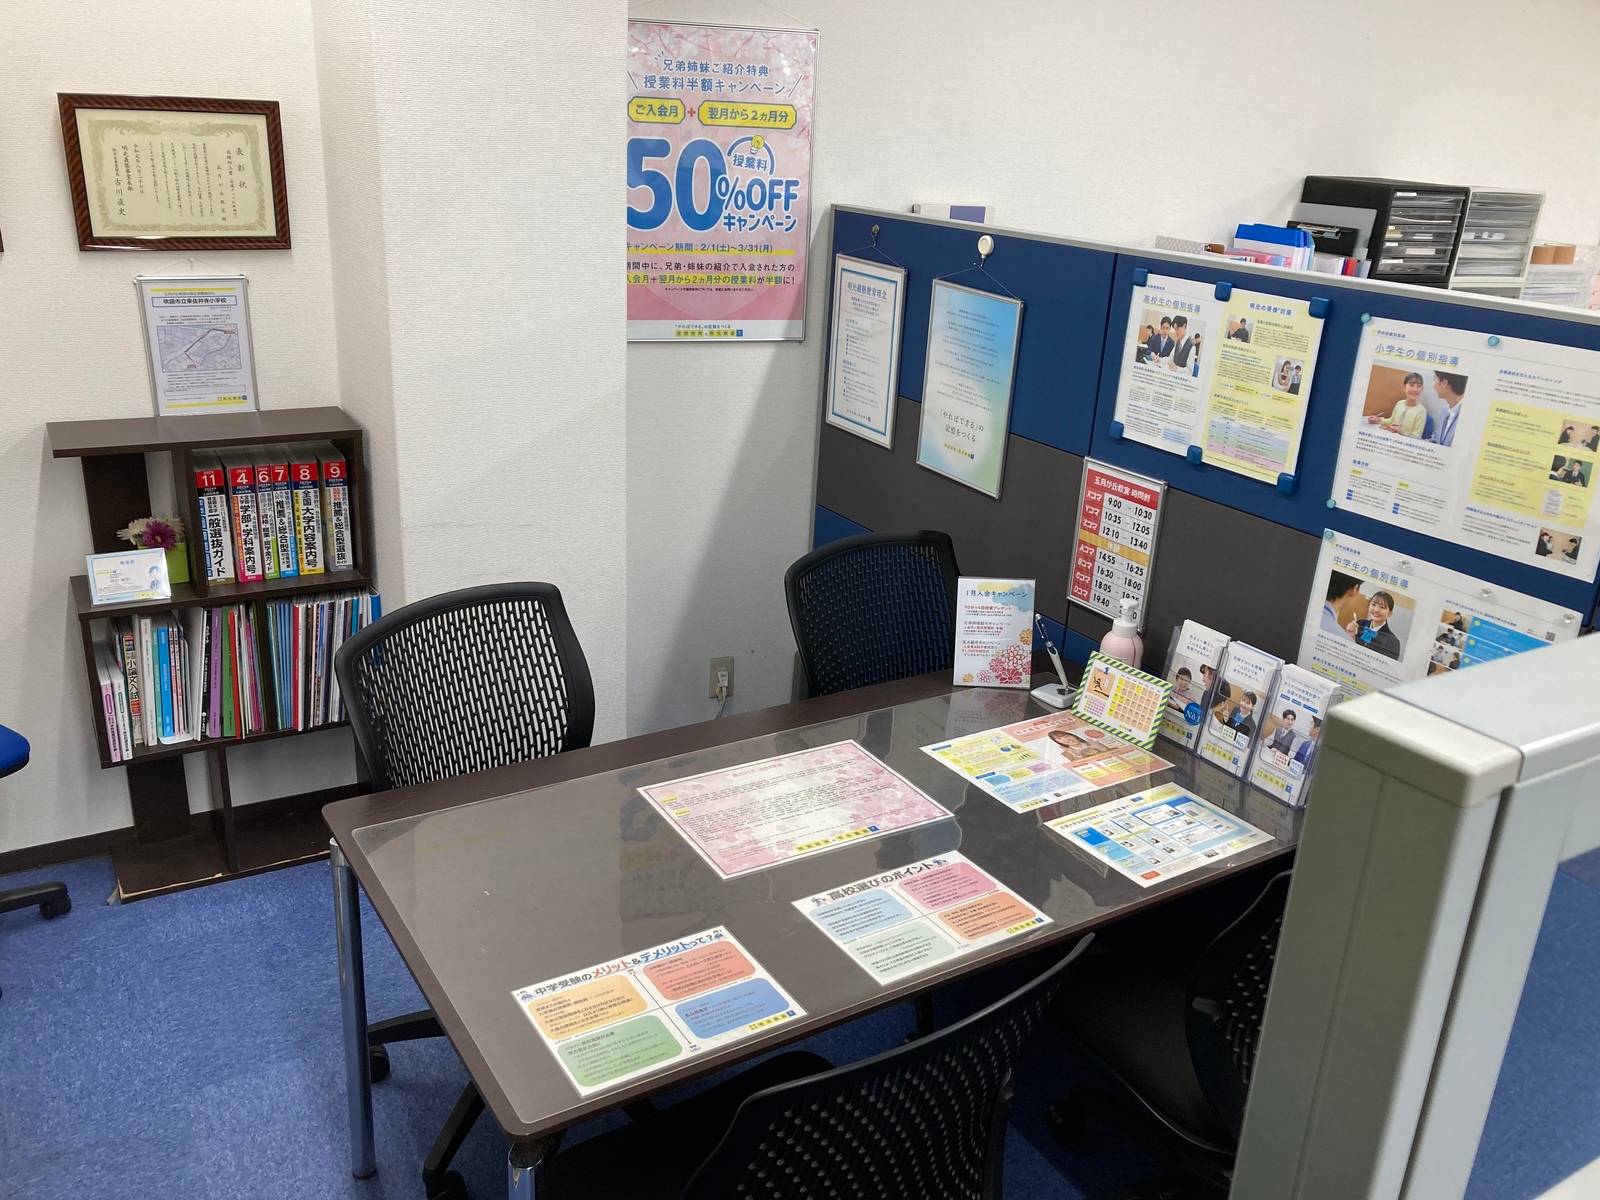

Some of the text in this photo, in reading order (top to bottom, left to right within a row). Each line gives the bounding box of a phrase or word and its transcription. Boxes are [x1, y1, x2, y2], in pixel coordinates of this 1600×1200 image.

[663, 59, 769, 77] 兄弟姉妹ご紹介特典
[643, 74, 786, 95] 授業料半額キャンペーン
[635, 104, 680, 118] ご入会月
[732, 154, 769, 173] 授業料
[723, 212, 798, 233] キャンペーン
[1143, 294, 1201, 314] 高校生の個別指導
[1374, 343, 1460, 367] 小学生の個別指導
[202, 474, 217, 487] 11
[237, 472, 248, 485] 4
[258, 470, 269, 483] 6
[275, 469, 286, 481] 7
[299, 468, 311, 481] 8
[330, 466, 341, 478] 9
[1094, 475, 1130, 495] 五月が丘教室
[1087, 490, 1153, 521] Xコマ 9:00 10:30
[1085, 504, 1150, 536] Yコマ 10:35 12:05
[208, 513, 226, 577] 一般選抜ガイド
[240, 505, 256, 574] 学部・学科案内号
[1102, 525, 1120, 540] 12:10
[1130, 536, 1148, 550] 13:40
[1098, 551, 1116, 565] 14:55
[1126, 562, 1144, 576] 16:25
[1332, 555, 1409, 590] 中学生の個別指導
[1094, 580, 1112, 594] 18:05
[1096, 566, 1114, 580] 16:30
[1124, 577, 1142, 591] 18:00
[966, 589, 1029, 599] 1月入会キャンペーン
[1092, 593, 1110, 607] 19:40
[827, 861, 935, 902] 高校選びのポイント
